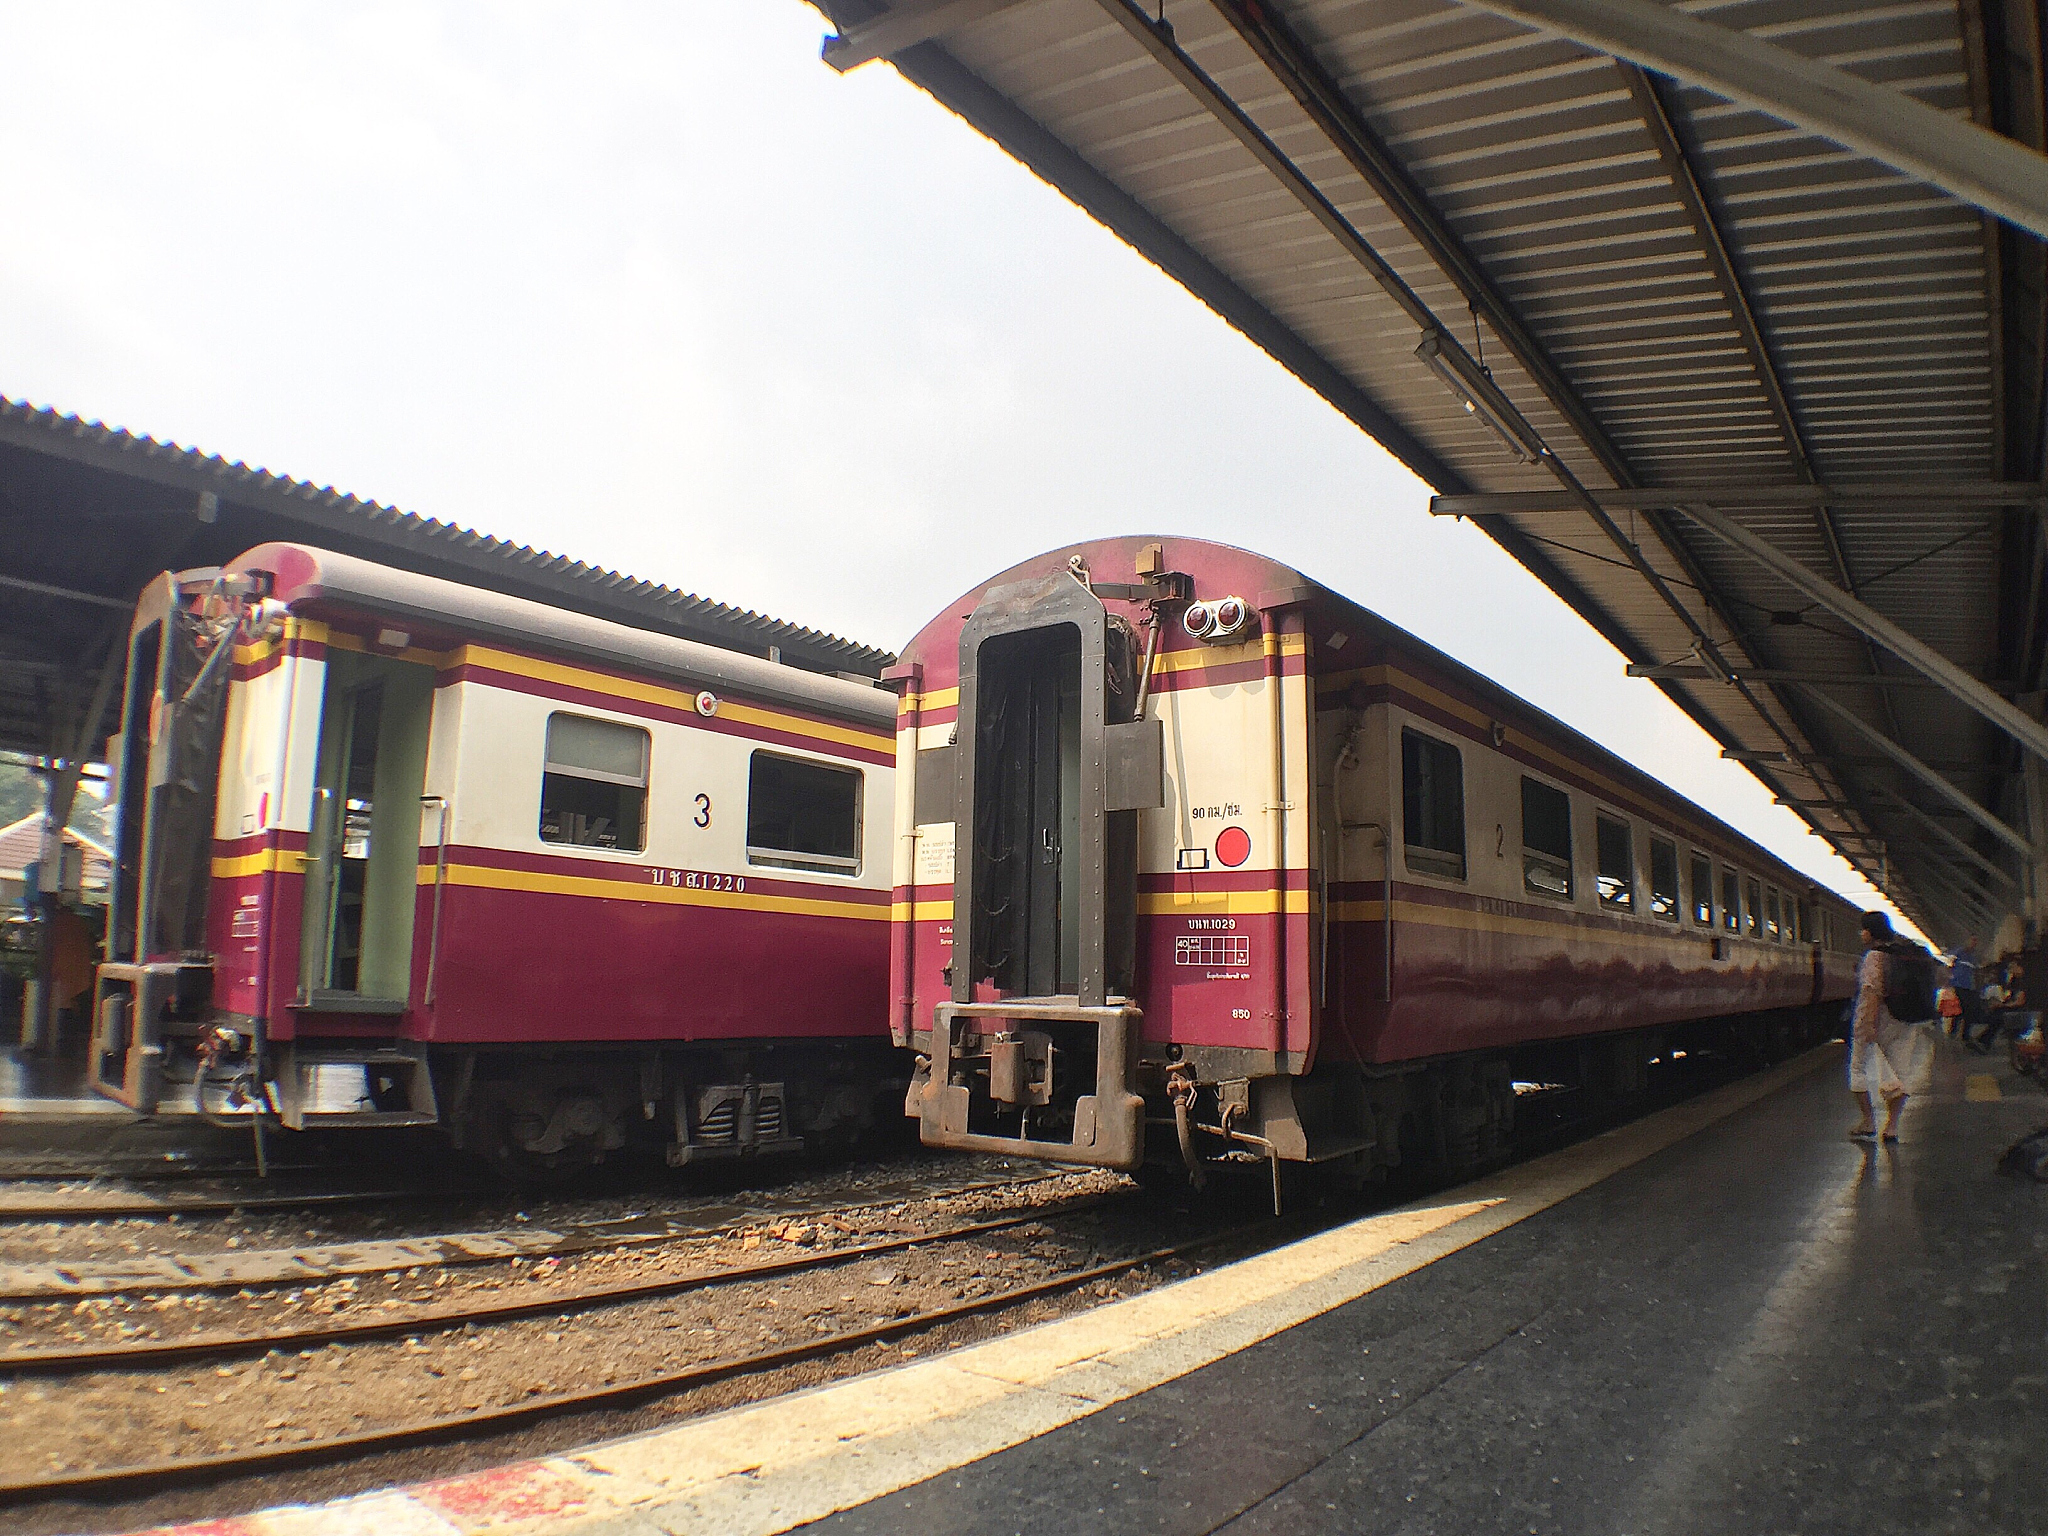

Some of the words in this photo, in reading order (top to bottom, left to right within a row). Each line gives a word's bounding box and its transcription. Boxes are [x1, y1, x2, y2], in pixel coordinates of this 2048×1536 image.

[693, 793, 713, 829] 3
[1192, 807, 1205, 819] 90
[1496, 824, 1504, 857] 2
[1231, 1008, 1251, 1020] 850
